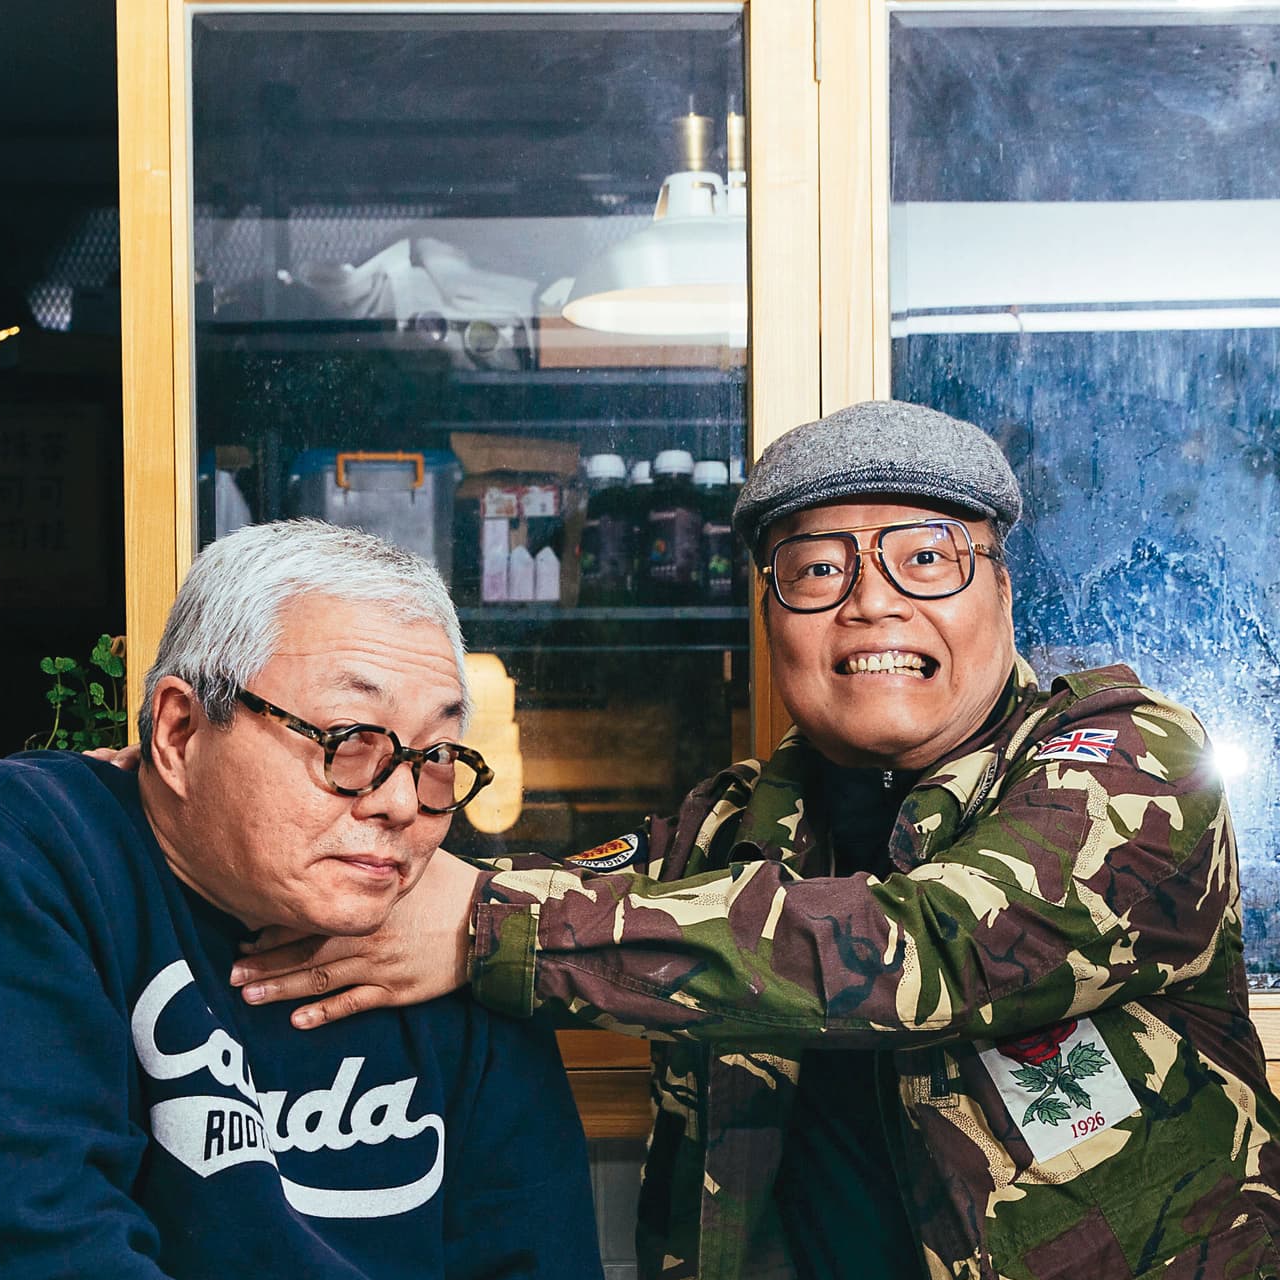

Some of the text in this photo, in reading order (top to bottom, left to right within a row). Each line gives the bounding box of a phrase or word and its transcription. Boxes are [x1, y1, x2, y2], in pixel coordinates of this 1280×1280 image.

[132, 960, 445, 1155] Cada
[204, 1110, 272, 1161] ROOT
[1072, 1111, 1105, 1138] 1926
